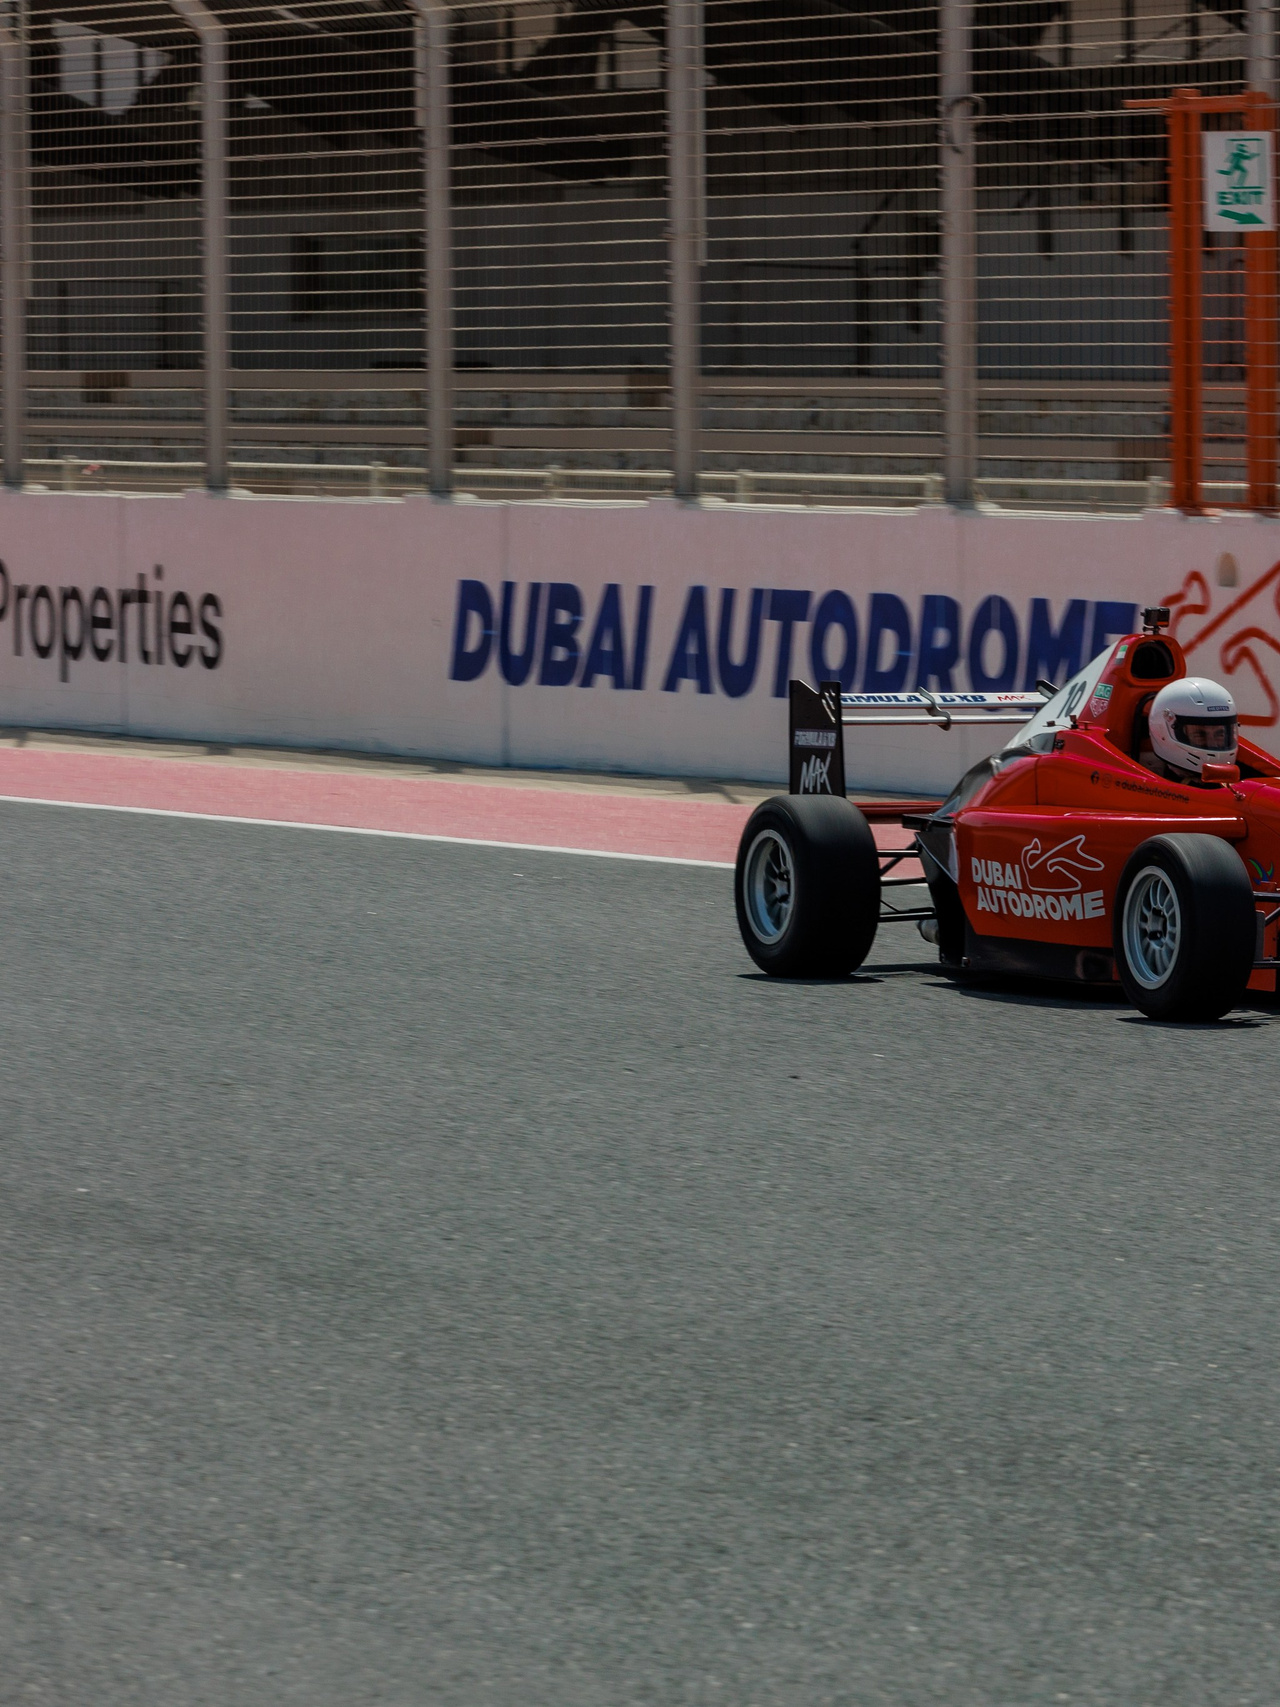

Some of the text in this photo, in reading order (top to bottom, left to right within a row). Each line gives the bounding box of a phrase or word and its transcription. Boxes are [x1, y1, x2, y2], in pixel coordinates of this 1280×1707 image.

[1216, 191, 1265, 205] EXIT
[448, 579, 655, 691] DUBAI
[841, 695, 923, 703] RMULA
[1056, 680, 1087, 718] 10
[1096, 684, 1112, 698] TAG
[799, 752, 833, 795] MAX
[971, 857, 1023, 890] DUBAI
[977, 886, 1106, 921] AUTODROME
